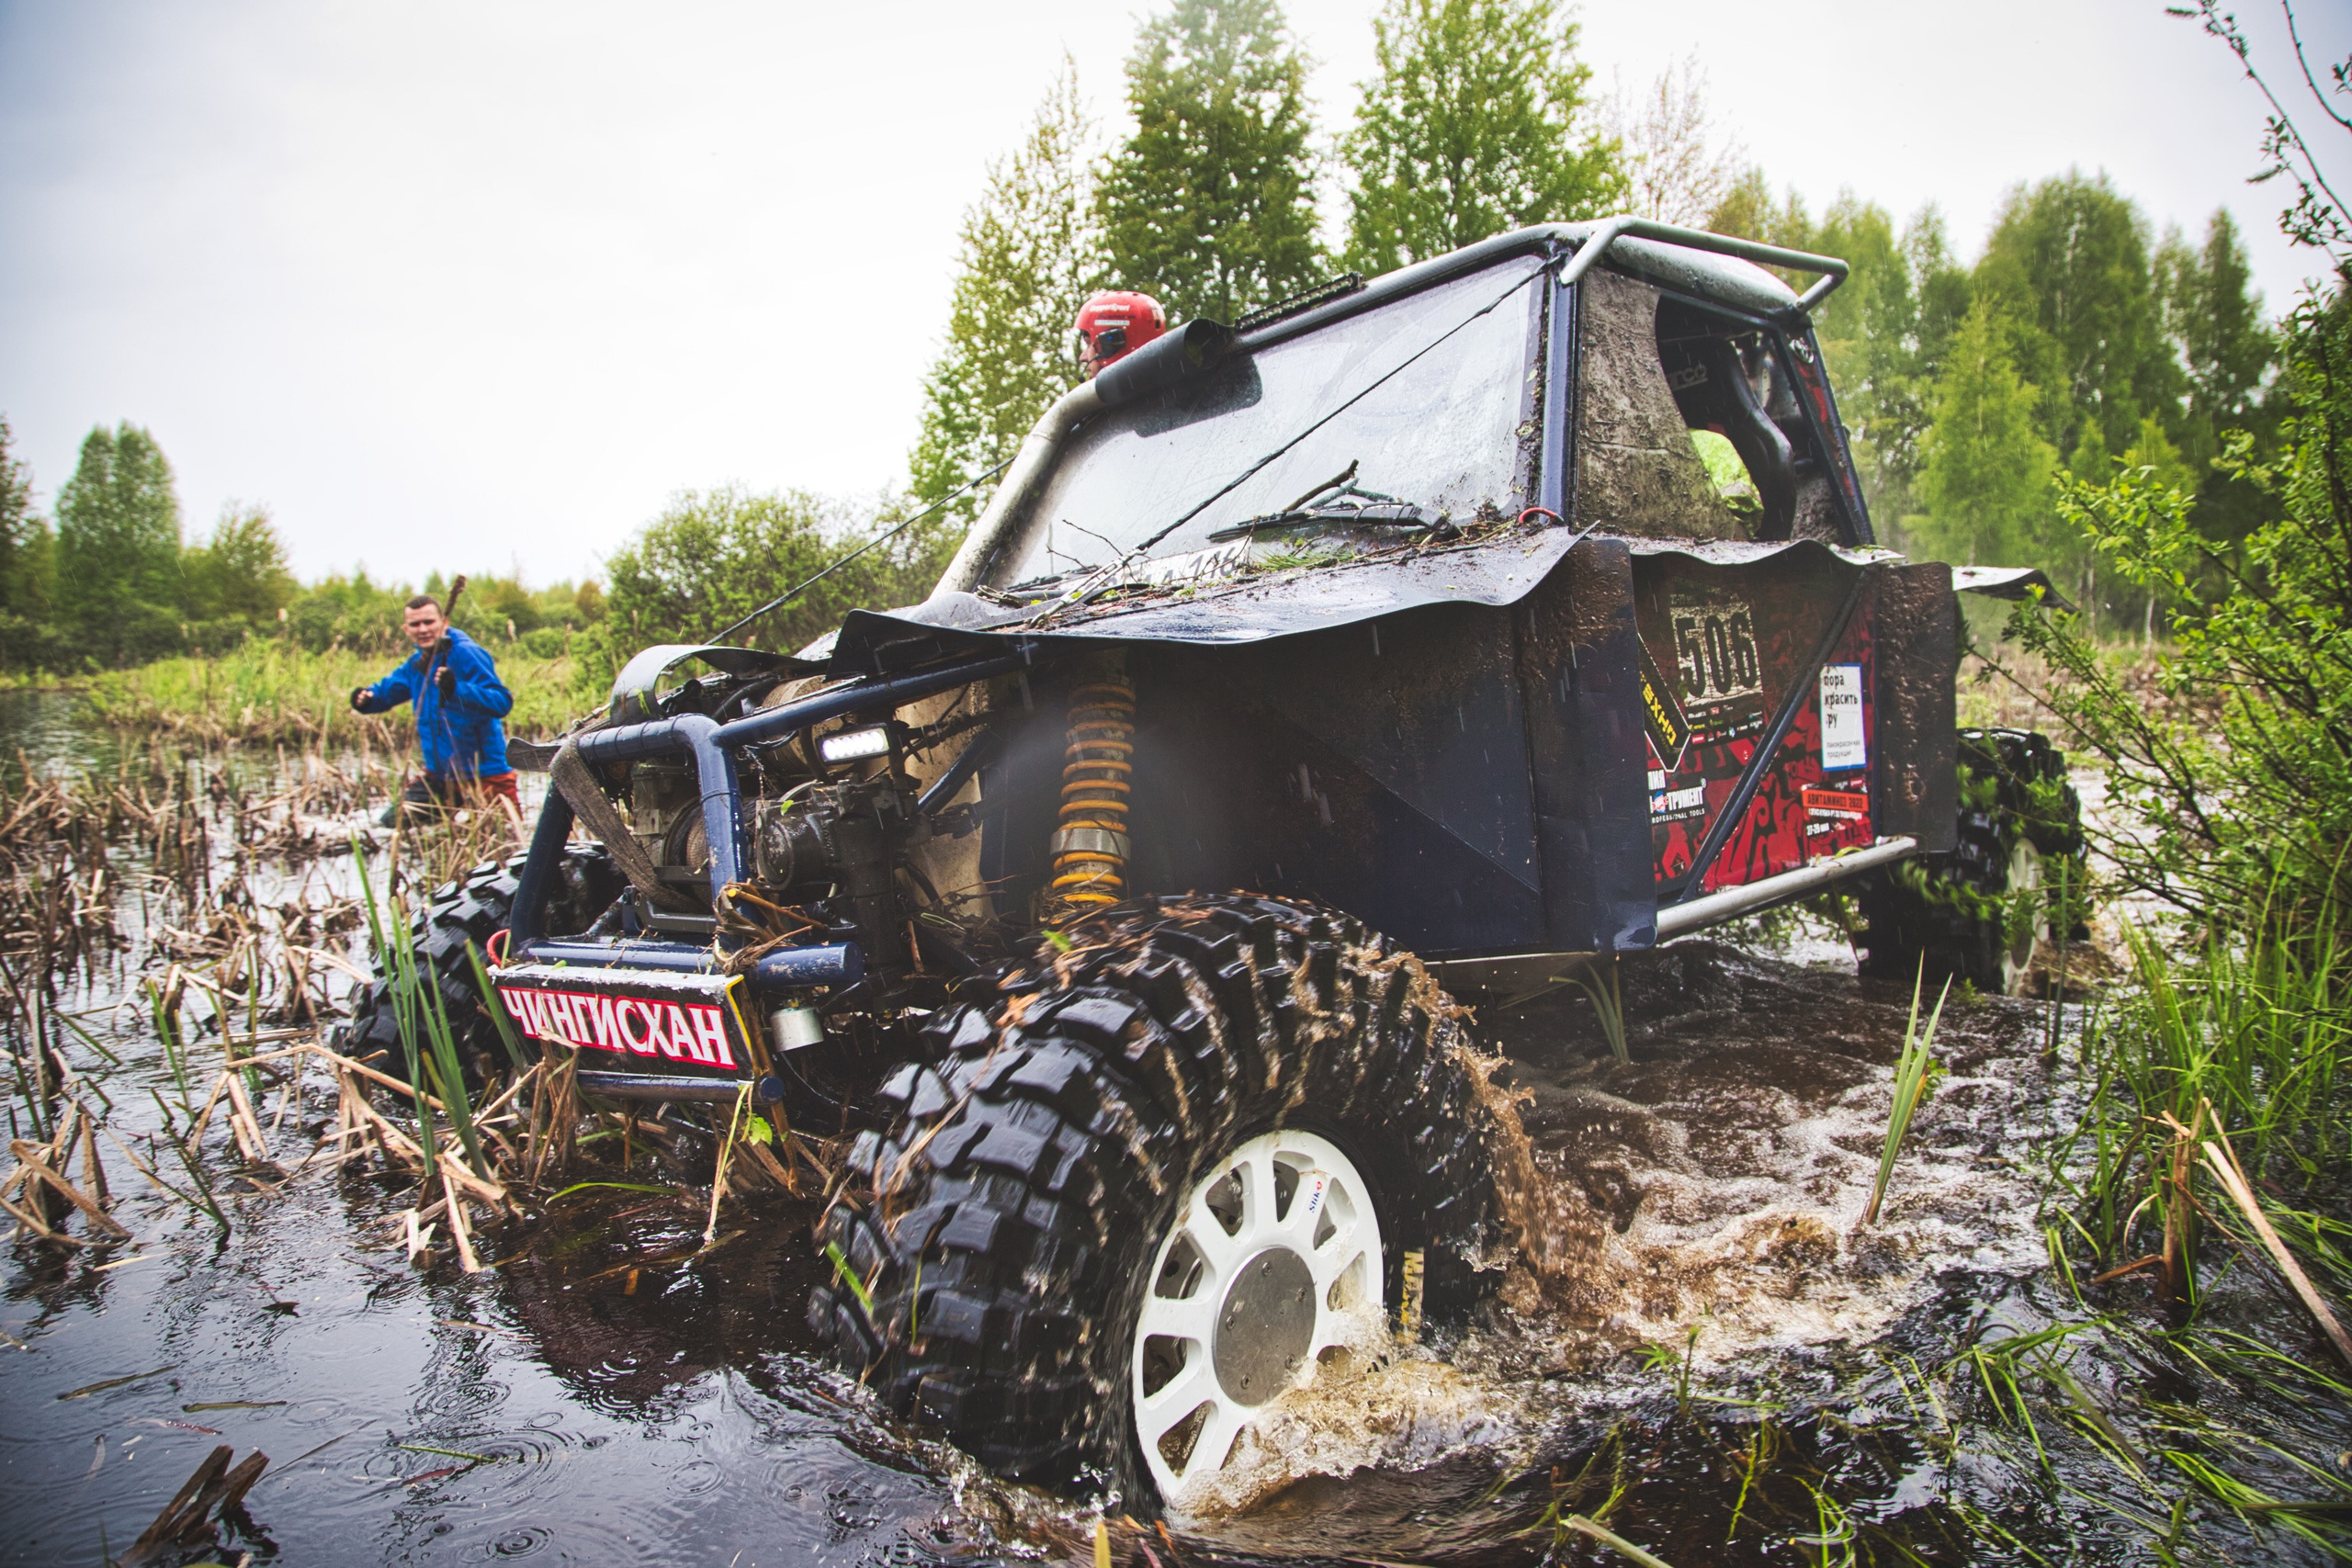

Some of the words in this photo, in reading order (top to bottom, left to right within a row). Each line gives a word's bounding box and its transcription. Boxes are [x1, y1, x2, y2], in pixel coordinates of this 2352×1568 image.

[1675, 612, 1758, 697] 506
[1824, 674, 1845, 690] пора
[1825, 693, 1859, 709] красить
[1807, 793, 1847, 807] АВИТАМИНОЗ
[1652, 812, 1688, 824] ROFESSIONAL
[1690, 807, 1705, 817] TOOLS
[501, 988, 736, 1066] ЧИНГИСХАН
